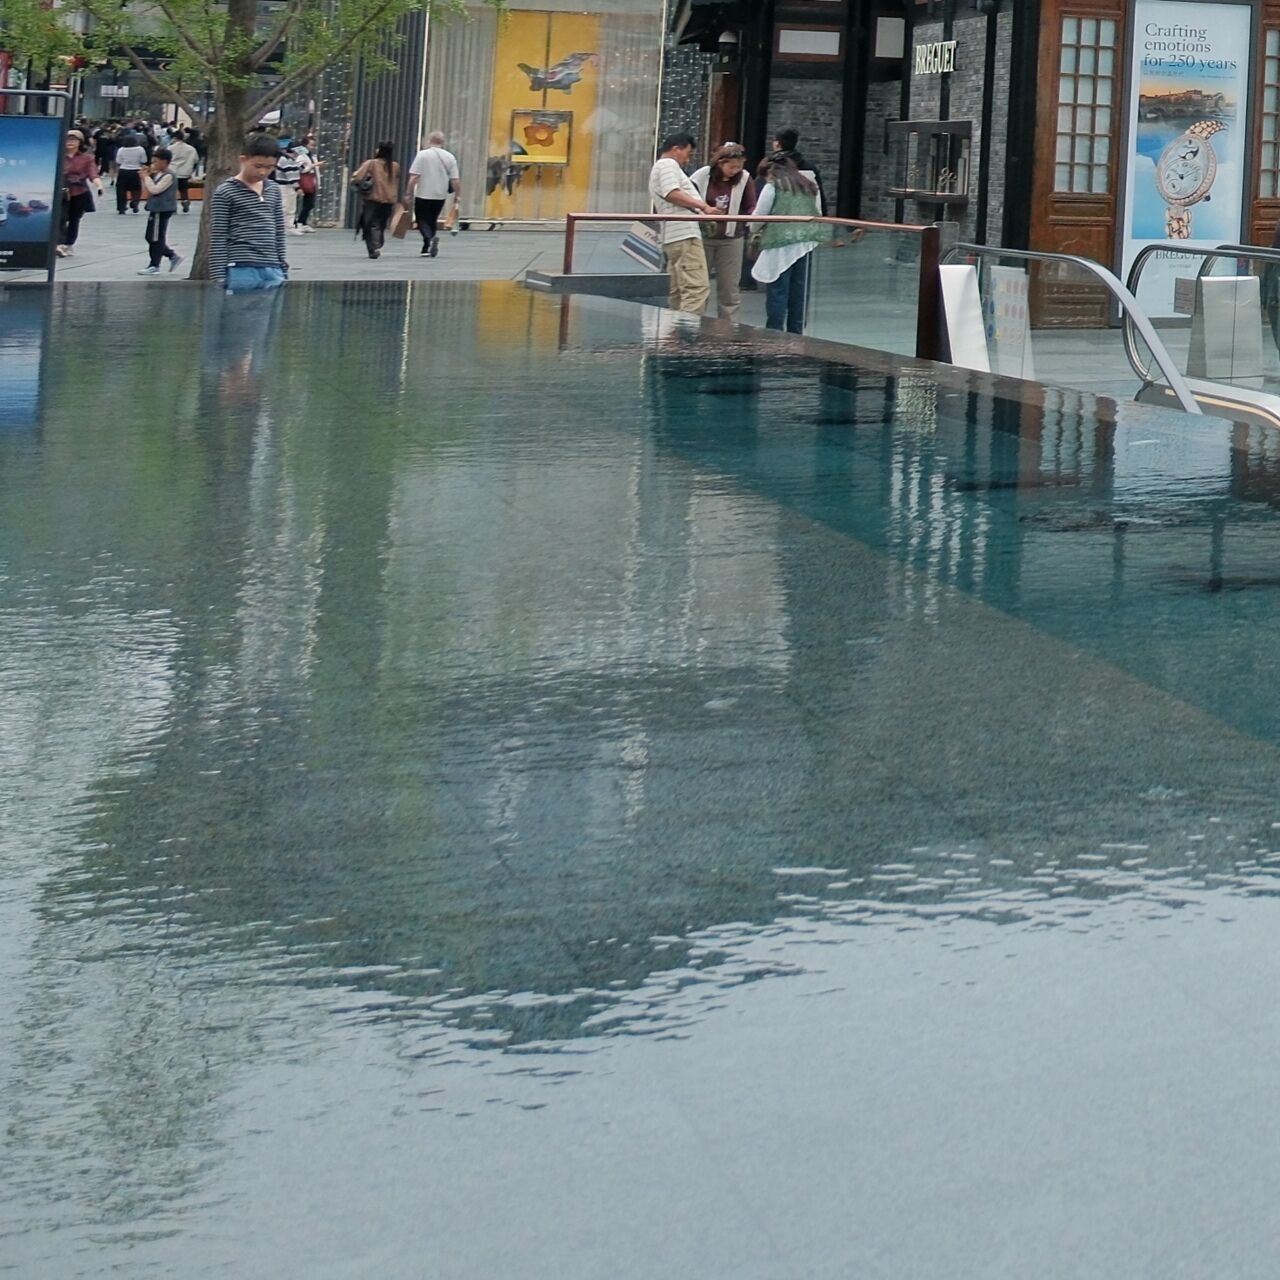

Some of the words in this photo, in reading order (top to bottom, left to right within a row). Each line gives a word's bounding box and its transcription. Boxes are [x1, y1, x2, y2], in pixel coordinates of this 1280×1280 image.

[1145, 23, 1207, 40] Crafting
[1144, 39, 1211, 52] emotions
[915, 41, 957, 74] BREGUET
[1143, 54, 1165, 67] for
[1168, 55, 1195, 68] 250
[1200, 59, 1237, 71] years
